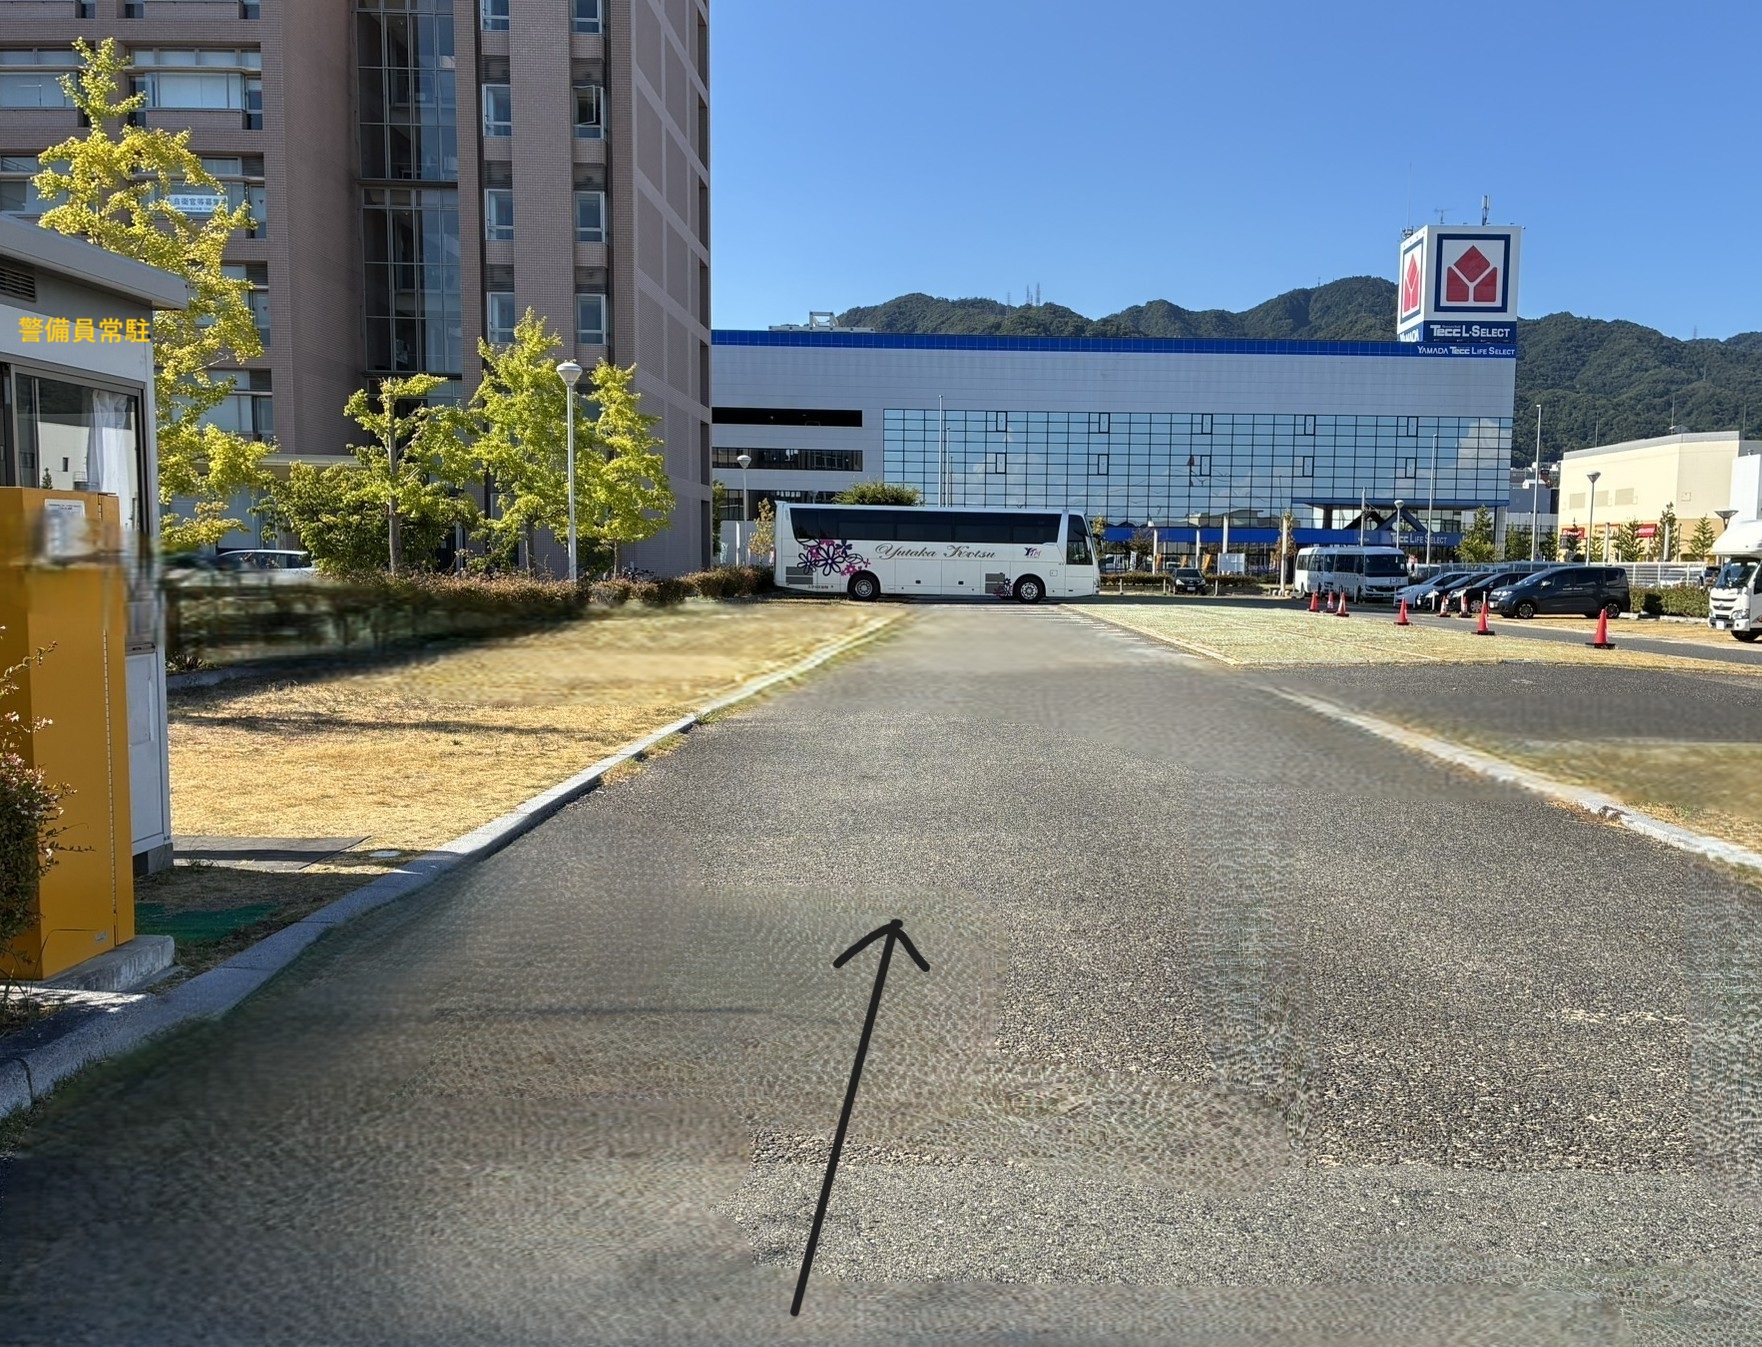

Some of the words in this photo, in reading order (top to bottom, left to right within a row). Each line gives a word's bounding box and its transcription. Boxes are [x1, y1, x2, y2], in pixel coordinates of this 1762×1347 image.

[1430, 325, 1461, 337] Tecc
[1417, 346, 1449, 355] YAMADA
[1471, 347, 1487, 355] LIFE
[1488, 347, 1515, 355] SELECT
[1410, 533, 1424, 544] LIFE
[875, 542, 937, 560] Yutaka
[943, 544, 996, 559] Kotsu
